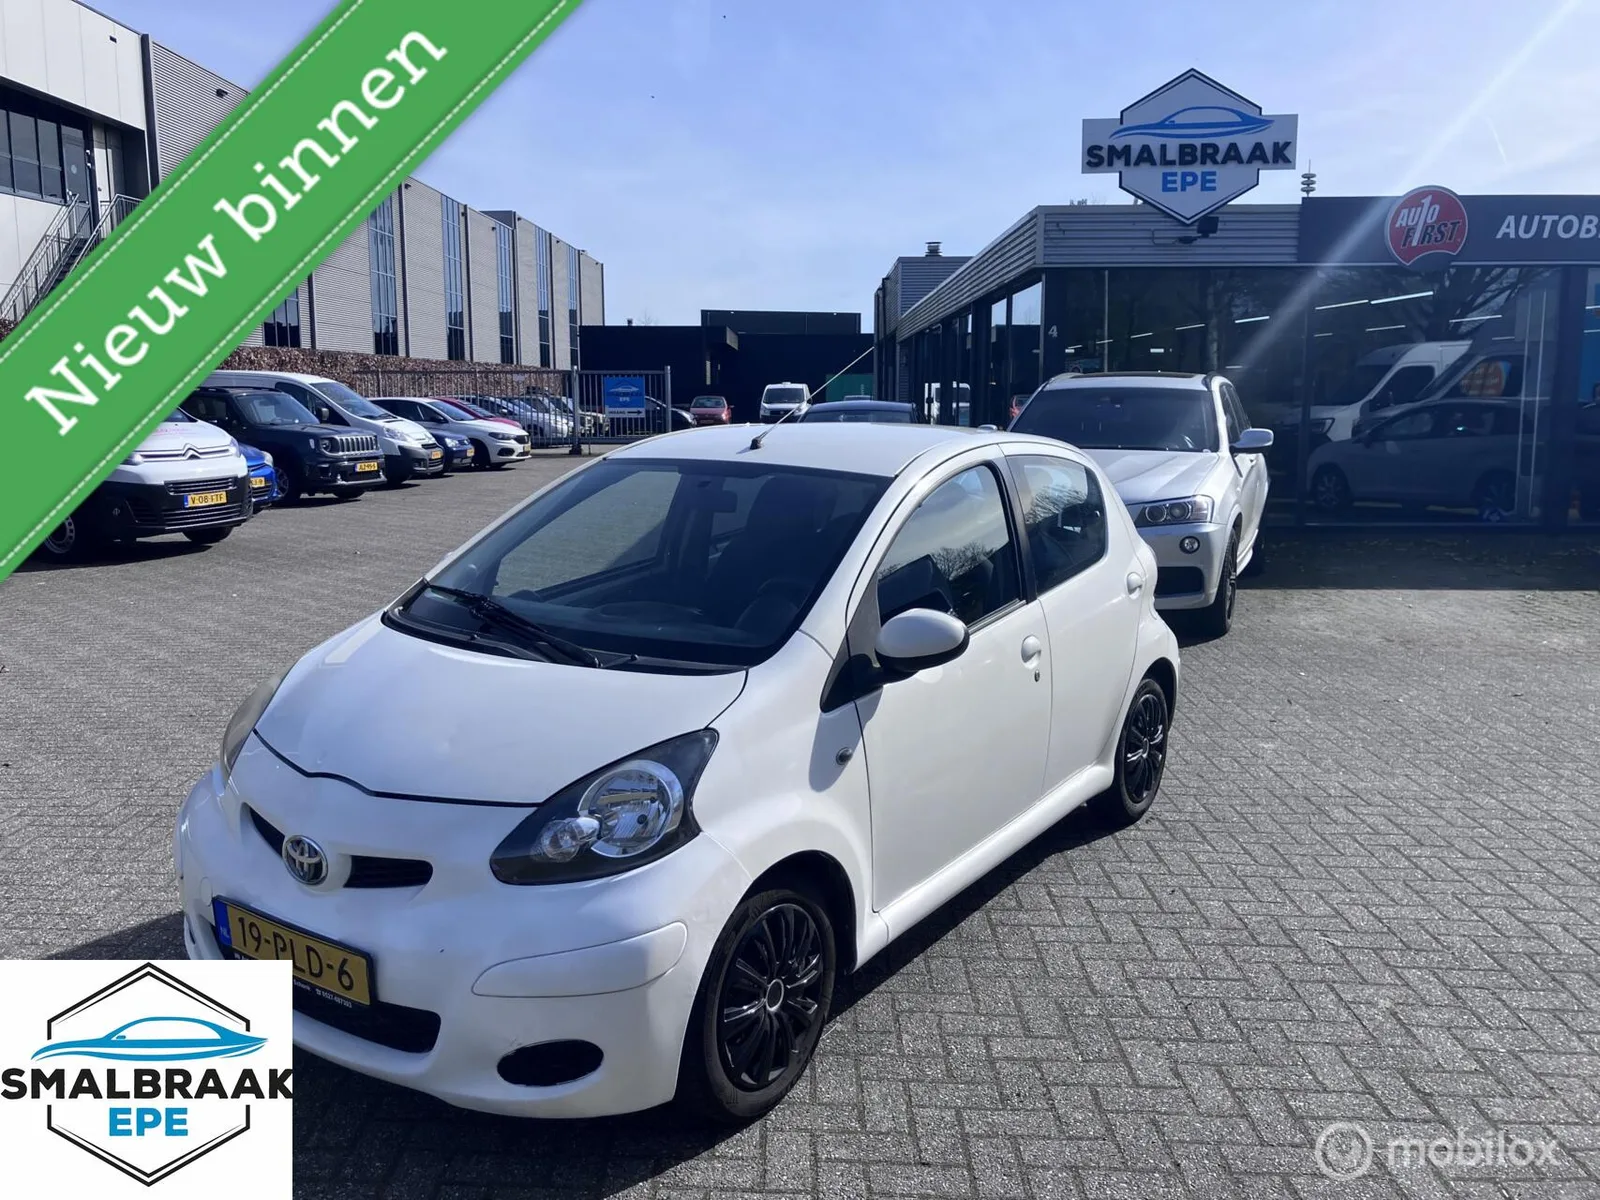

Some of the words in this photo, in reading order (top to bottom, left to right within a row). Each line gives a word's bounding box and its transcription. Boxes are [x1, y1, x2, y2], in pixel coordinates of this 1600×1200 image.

[1086, 141, 1293, 168] SMALBRAAK
[1161, 171, 1217, 192] EPE
[1496, 214, 1600, 240] AUTOB
[1048, 325, 1058, 338] 4
[237, 916, 355, 992] 19-PLD-6
